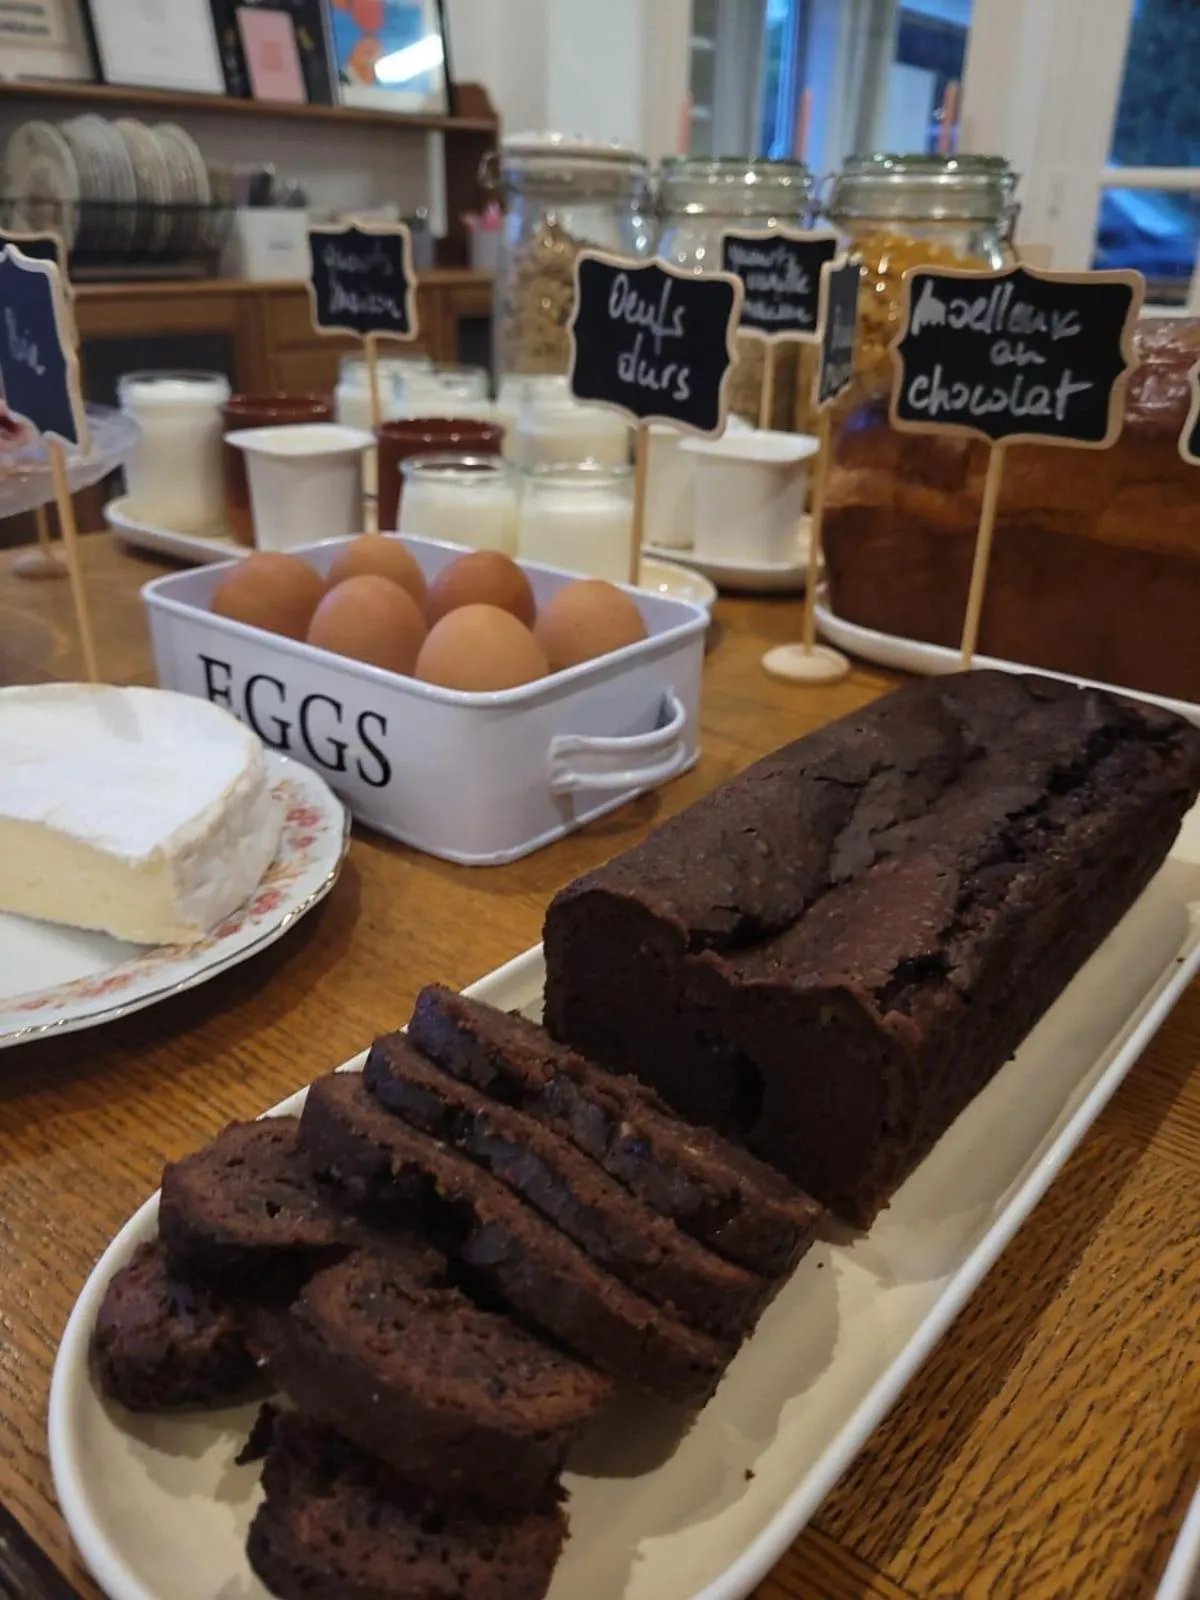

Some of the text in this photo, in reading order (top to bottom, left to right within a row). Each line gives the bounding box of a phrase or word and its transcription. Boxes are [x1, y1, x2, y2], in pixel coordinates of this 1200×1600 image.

[608, 272, 686, 356] Oeufs
[616, 331, 690, 401] durs
[907, 364, 1094, 421] chocolat
[197, 652, 392, 788] EGGS
